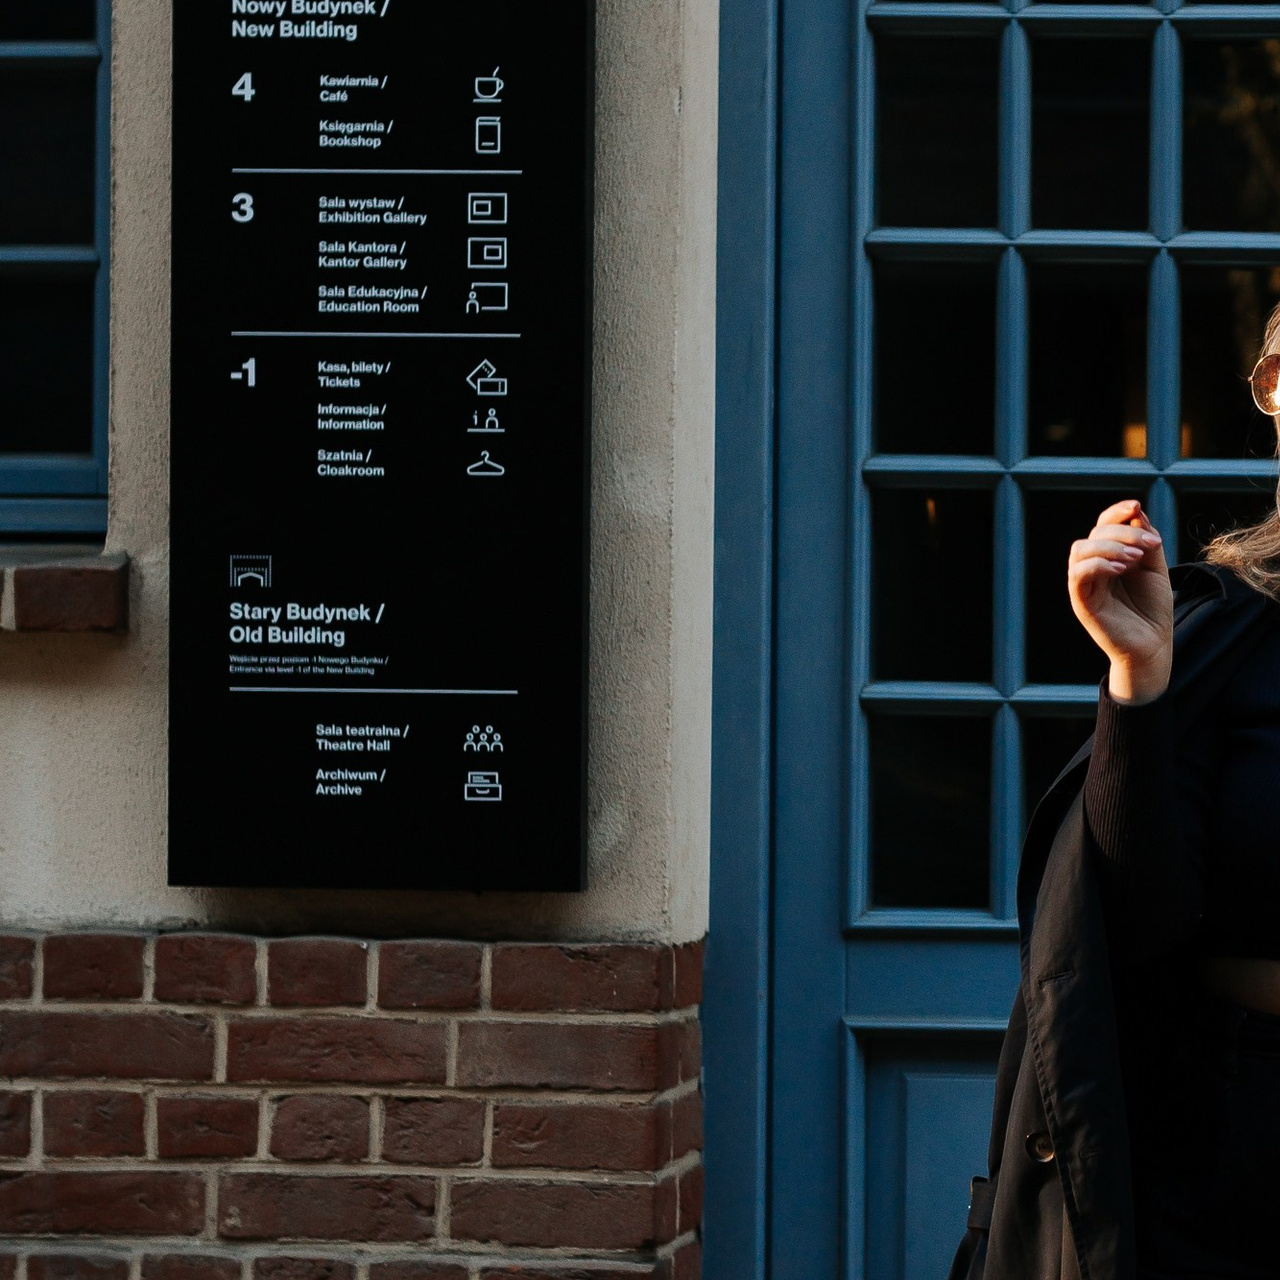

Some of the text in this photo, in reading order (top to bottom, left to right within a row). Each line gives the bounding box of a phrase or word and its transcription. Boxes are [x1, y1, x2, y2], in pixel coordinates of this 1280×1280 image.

[232, 20, 357, 41] New Building
[232, 72, 255, 101] 4
[320, 75, 379, 86] Kawiarnia
[320, 90, 348, 102] Café
[320, 120, 384, 134] Księgarnia
[320, 135, 381, 148] Bookshop
[232, 193, 254, 222] 3
[319, 196, 345, 208] Sala
[349, 198, 395, 210] wystaw
[319, 211, 427, 225] Exhibition Gallery
[319, 241, 345, 252] Sala
[348, 241, 397, 253] Kantora
[319, 256, 407, 269] Kantor Gallery
[319, 286, 345, 297] Sala
[348, 286, 418, 302] Edukacyjna
[319, 300, 419, 312] Education Room
[231, 358, 255, 387] -1
[352, 362, 383, 374] bilety
[318, 376, 360, 387] Tickets
[318, 404, 379, 419] Informacja
[318, 418, 384, 429] Information
[318, 449, 363, 461] Szatnia
[317, 464, 384, 476] Cloakroom
[230, 602, 281, 623] Stary
[287, 603, 370, 623] Budynek
[230, 626, 345, 647] Old Building
[345, 666, 374, 675] Building
[316, 724, 342, 735] Sala
[346, 725, 400, 736] teatralna
[316, 739, 390, 751] Theatre Hall
[316, 769, 377, 780] Archiwum
[316, 783, 362, 795] Archive
